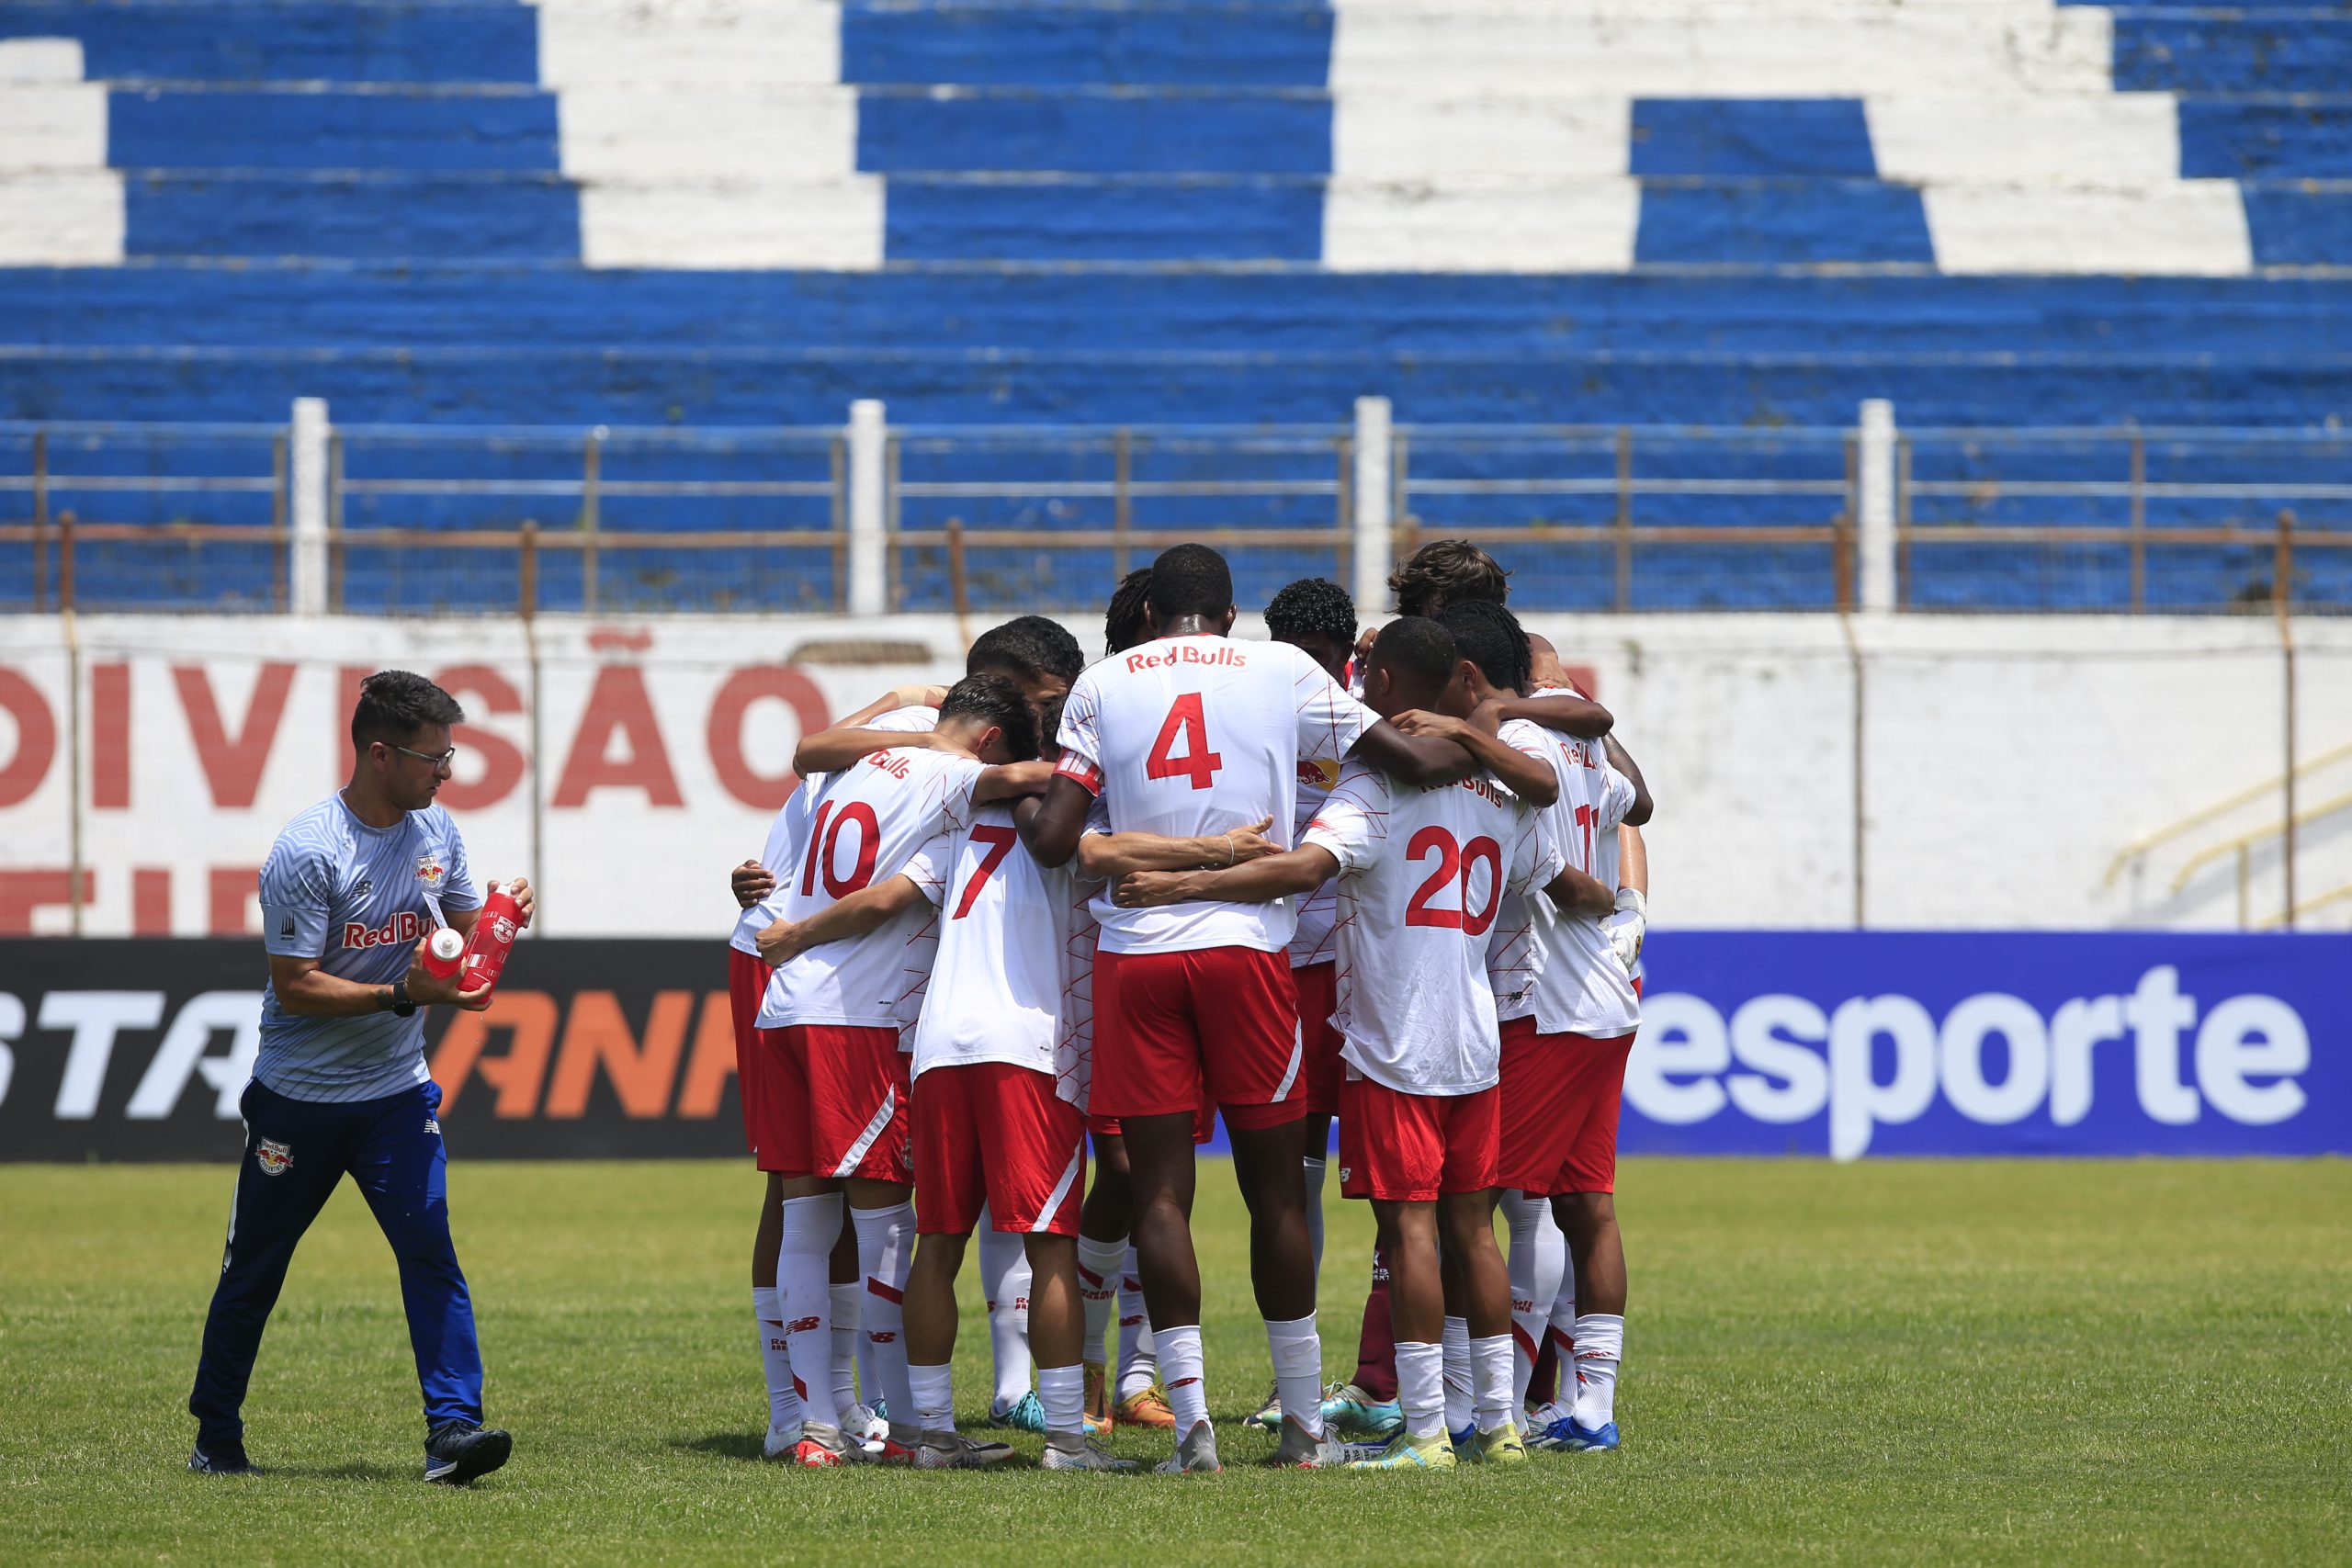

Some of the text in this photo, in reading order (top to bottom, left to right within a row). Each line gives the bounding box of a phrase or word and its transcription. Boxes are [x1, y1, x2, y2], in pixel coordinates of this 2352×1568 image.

[1146, 692, 1222, 789] 4
[801, 799, 880, 900] 10
[952, 824, 1018, 919] 7
[1405, 825, 1503, 935] 20
[399, 911, 435, 942] Bu
[0, 990, 266, 1120] TA
[1621, 964, 2312, 1163] esporte
